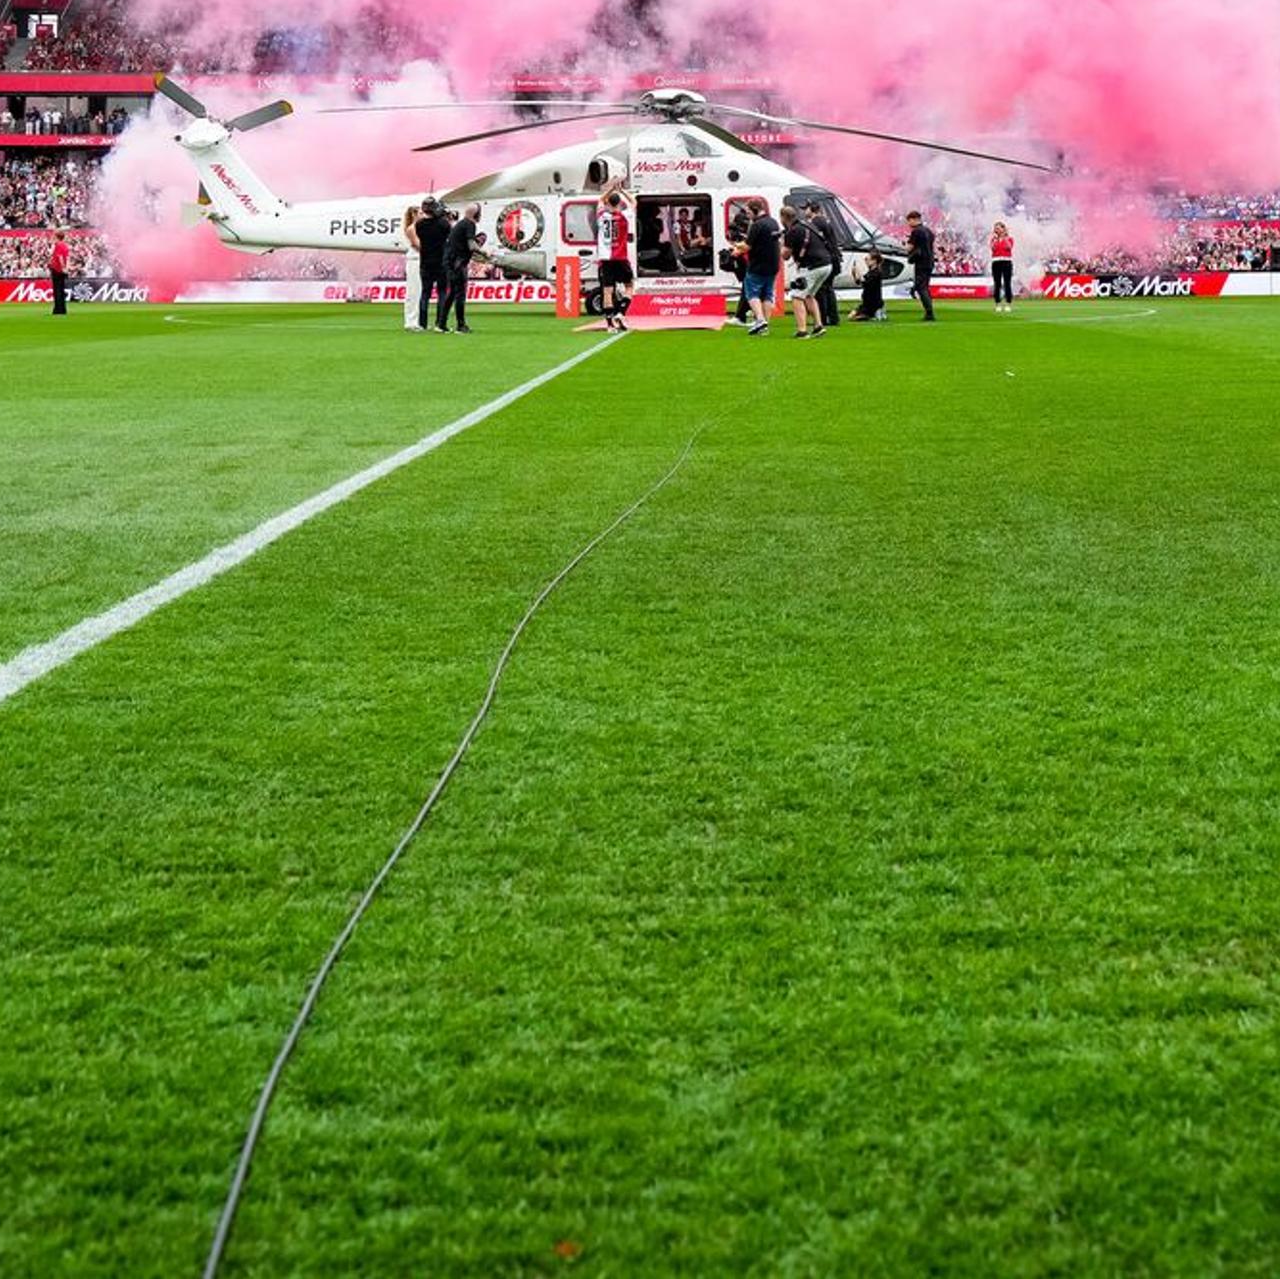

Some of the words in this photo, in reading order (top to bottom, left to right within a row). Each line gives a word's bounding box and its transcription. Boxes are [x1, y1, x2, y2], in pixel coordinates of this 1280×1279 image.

[329, 218, 402, 235] PH-SSF
[89, 281, 149, 301] Markt
[323, 285, 348, 300] en
[466, 282, 514, 300] irect
[514, 282, 535, 303] je
[1044, 276, 1112, 298] Media
[1131, 275, 1195, 297] Markt
